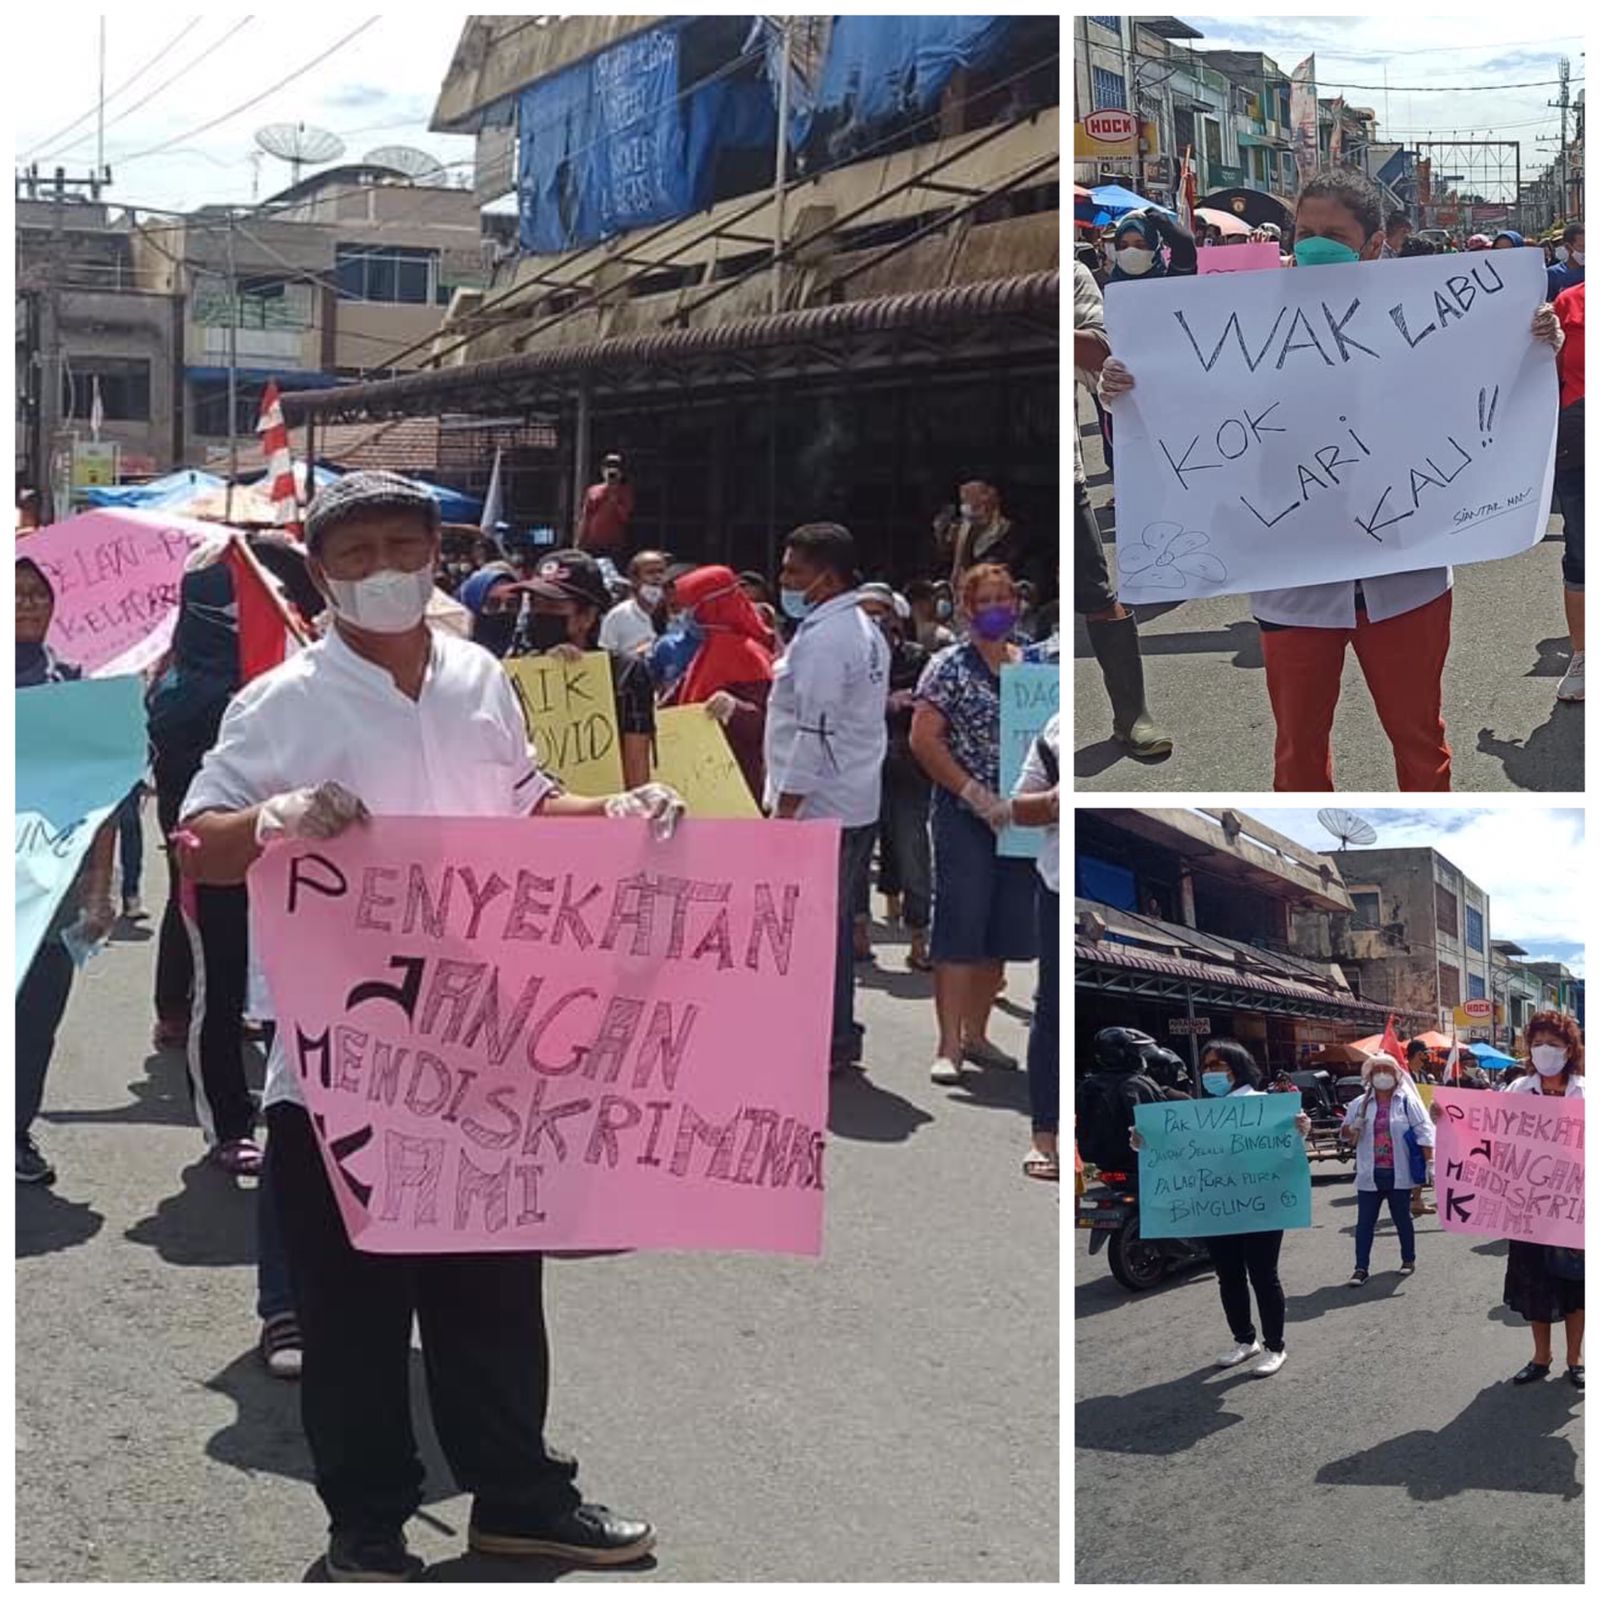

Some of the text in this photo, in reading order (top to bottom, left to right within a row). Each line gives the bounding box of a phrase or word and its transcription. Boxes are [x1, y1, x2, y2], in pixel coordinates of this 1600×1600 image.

[1090, 119, 1132, 134] HOCK
[1173, 259, 1504, 373] WAK LABU
[1158, 401, 1286, 490] KOK
[287, 853, 800, 976] PENYEKATAN
[345, 954, 699, 1091] JANGAN
[1466, 1003, 1490, 1013] HOCK
[296, 1020, 826, 1191] MENDISKRIMINASI
[313, 1113, 547, 1233] KAMI
[1446, 1187, 1534, 1235] KAMI
